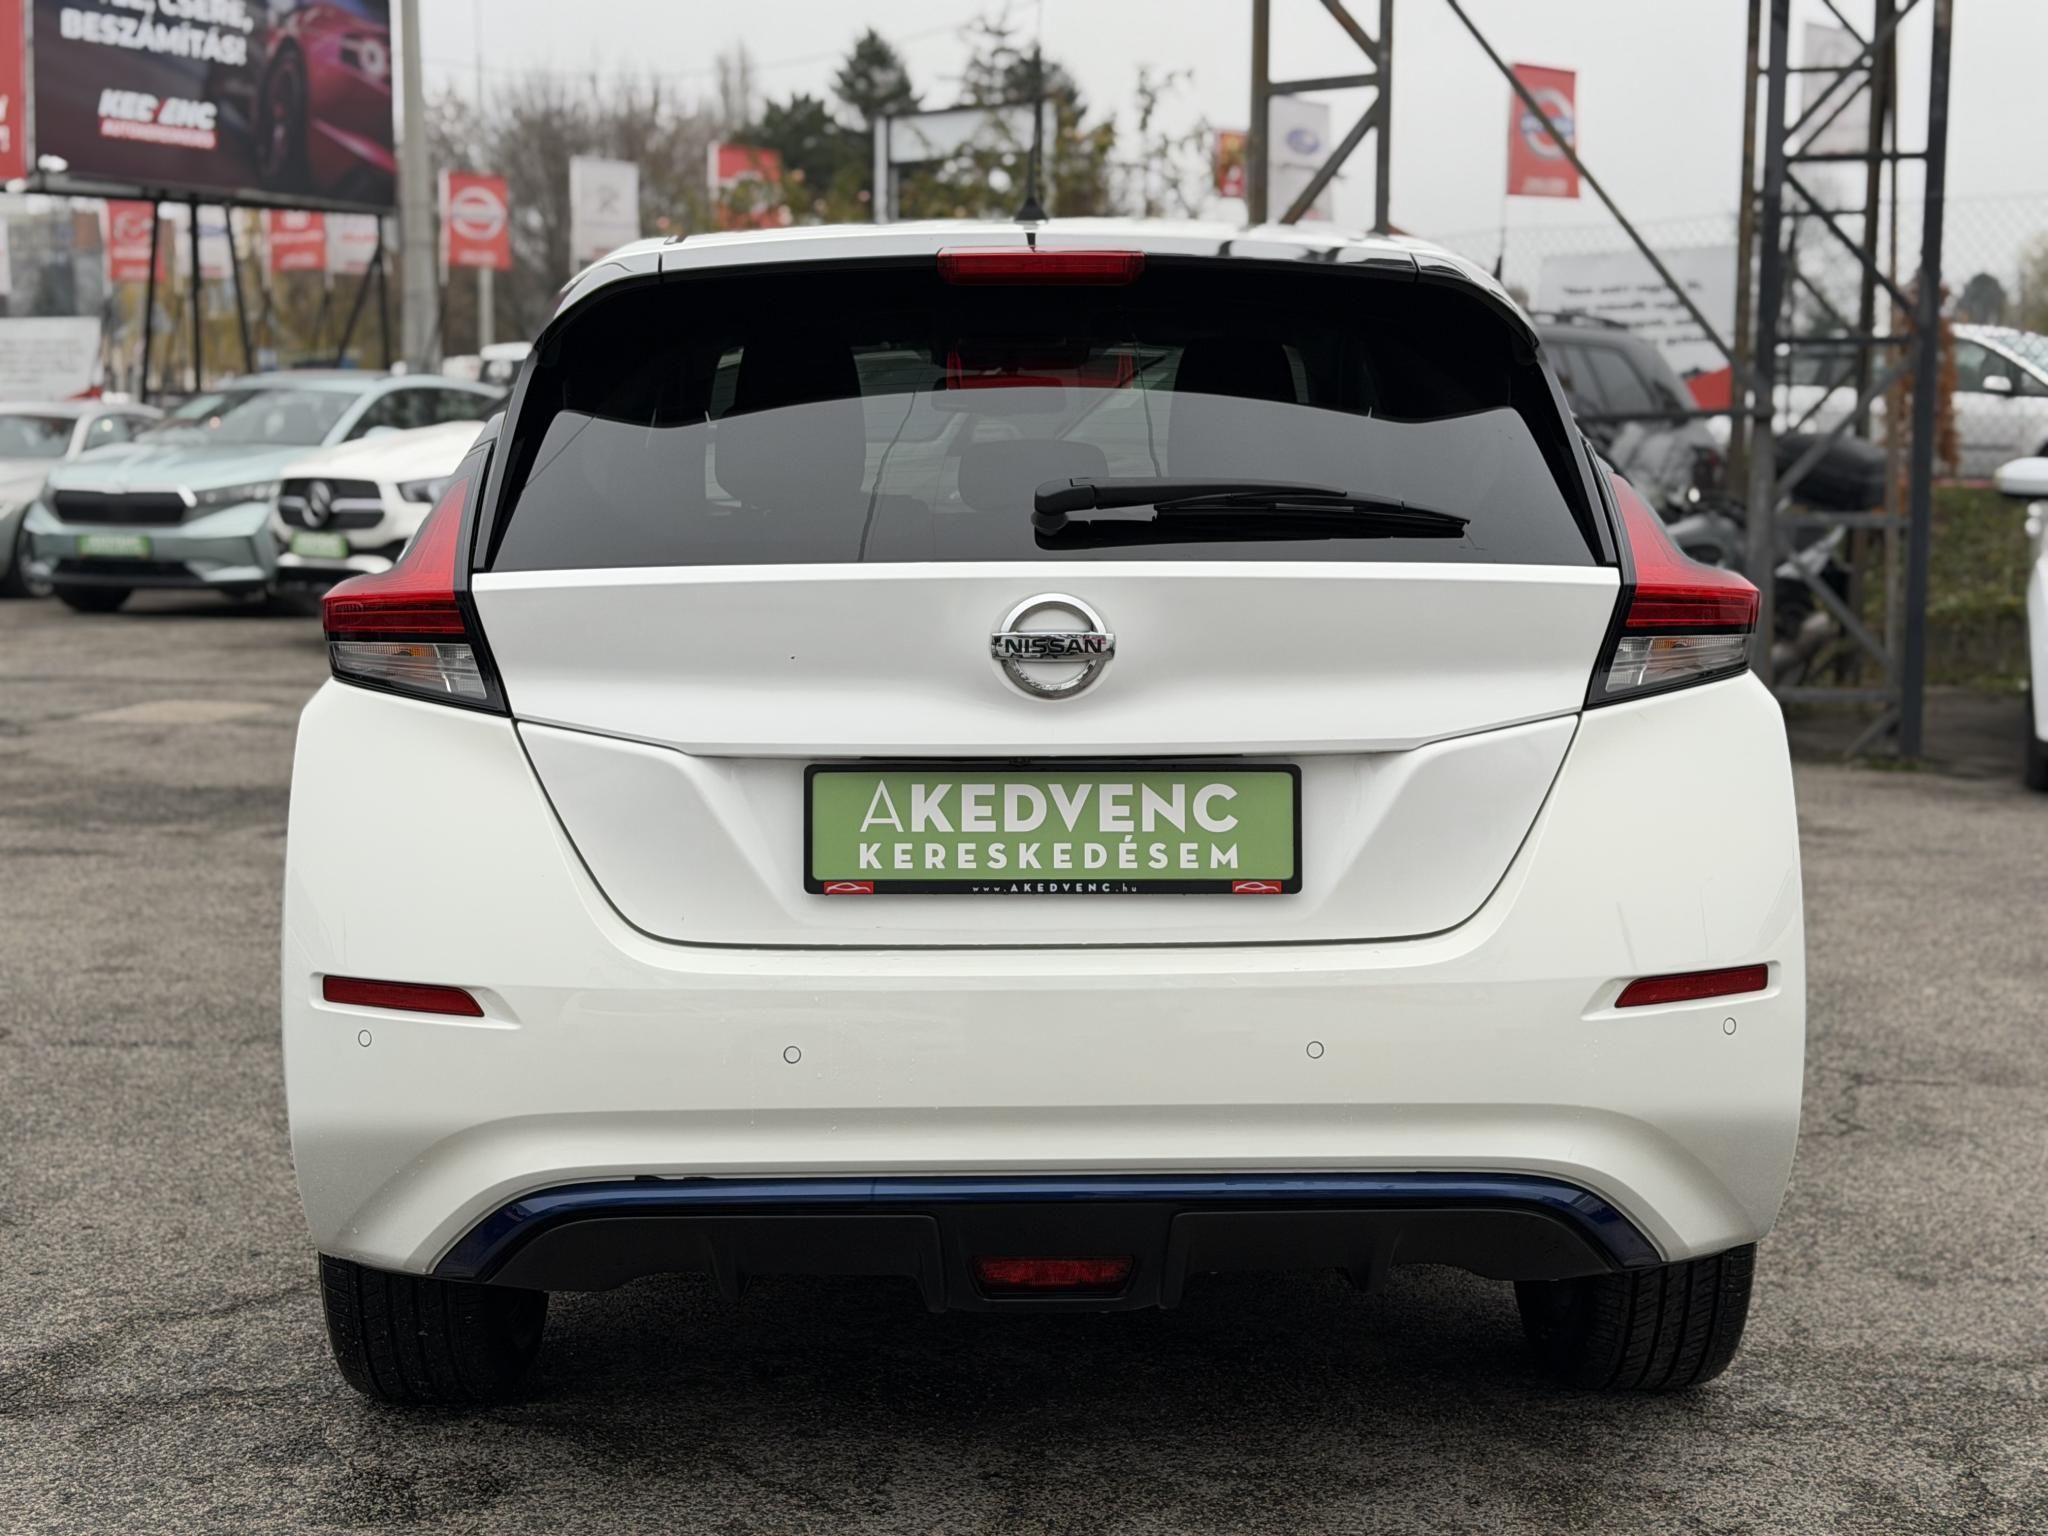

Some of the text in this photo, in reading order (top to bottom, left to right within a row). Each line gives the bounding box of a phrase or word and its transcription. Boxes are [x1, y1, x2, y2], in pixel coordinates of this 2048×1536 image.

[1005, 638, 1102, 654] NISSAN
[859, 835, 1239, 870] KERESKEDÉSEM
[972, 883, 1137, 893] www.AKEDVENC.hu
